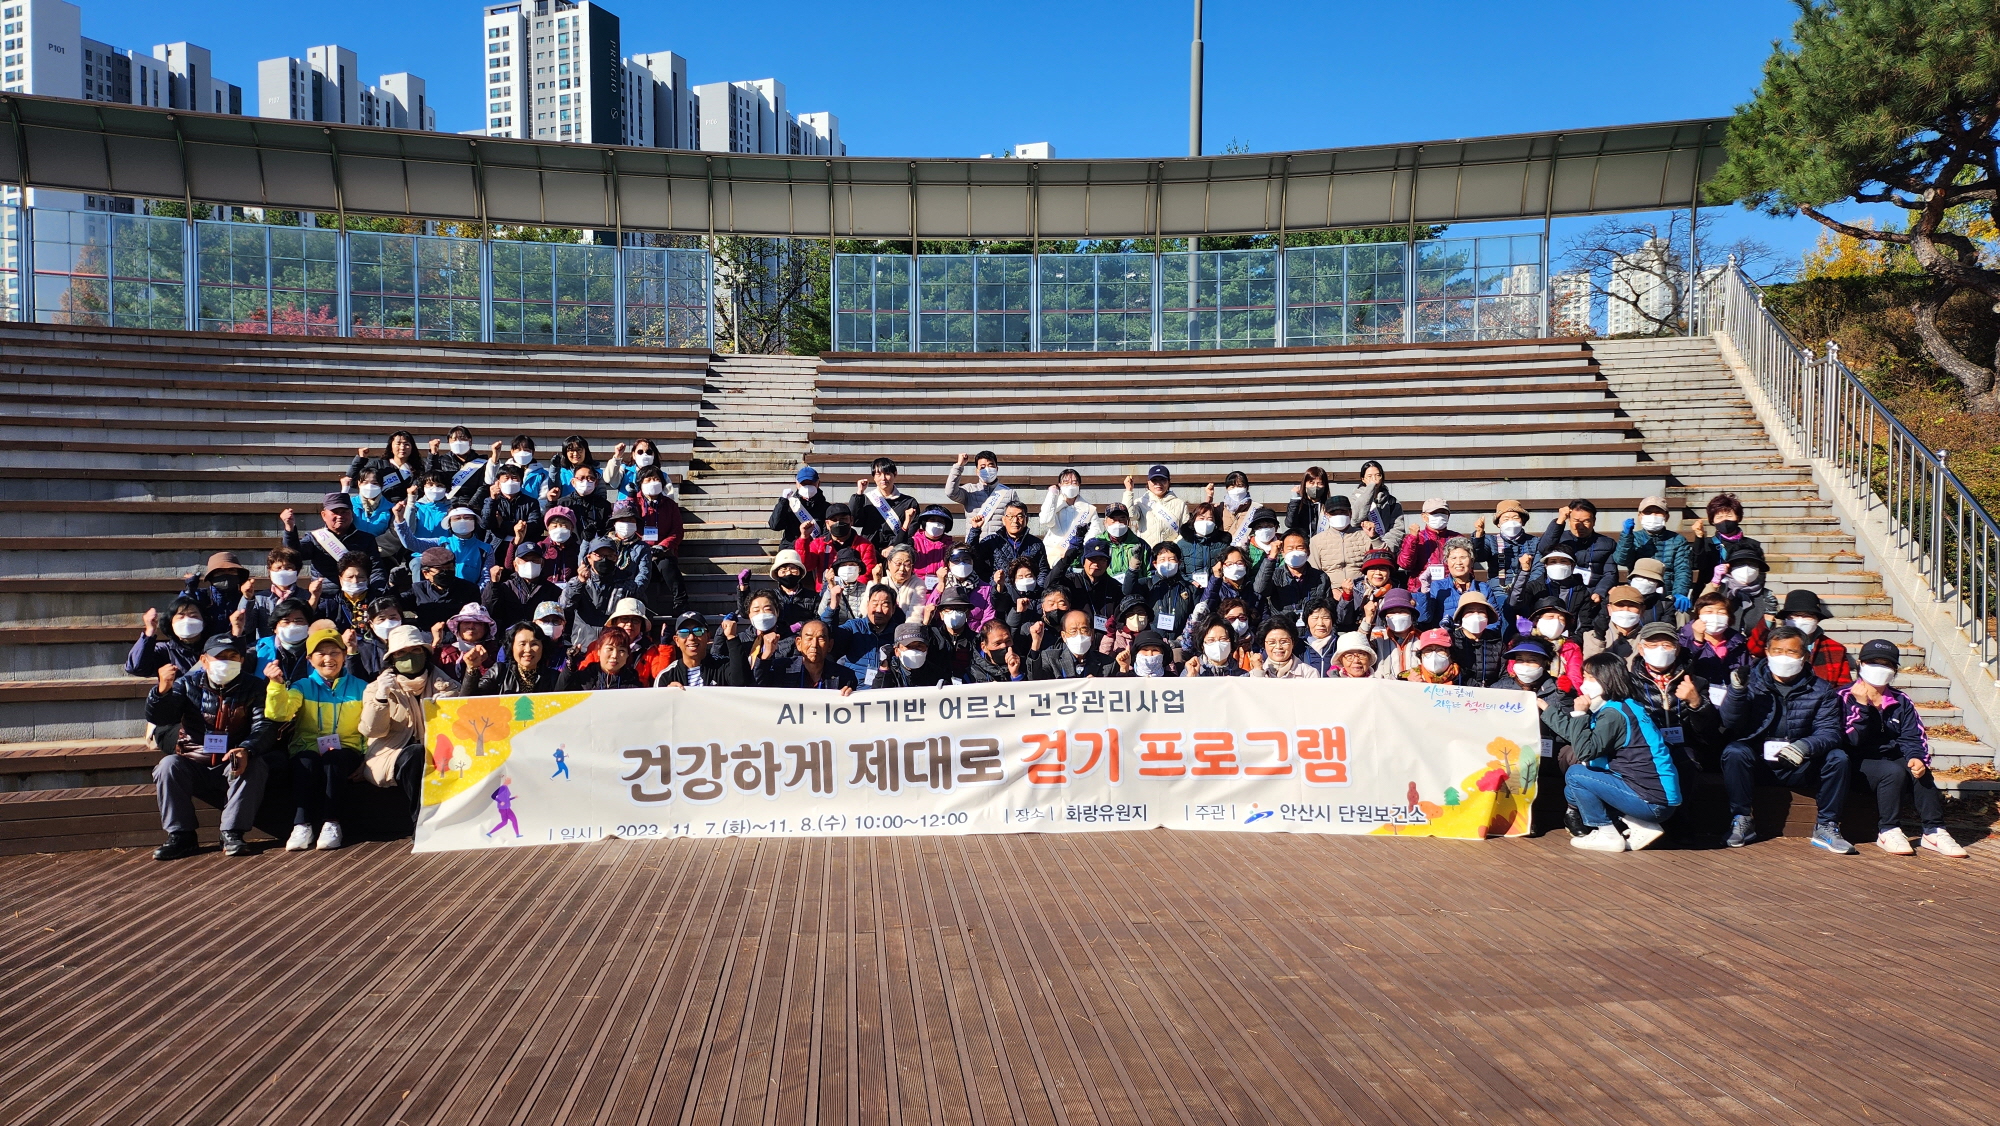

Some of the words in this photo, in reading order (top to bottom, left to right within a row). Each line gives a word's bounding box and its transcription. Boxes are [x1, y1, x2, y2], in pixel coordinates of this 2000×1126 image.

[48, 43, 65, 54] P101
[939, 694, 1016, 720] 어르신
[1028, 690, 1185, 717] 건강관리사업
[1499, 701, 1525, 713] 안산
[621, 740, 834, 802] 건강하게
[848, 735, 1004, 792] 제대로
[1020, 728, 1120, 785] 걷기
[1138, 725, 1348, 784] 프로그램
[855, 811, 968, 830] 10:00~12:00
[1015, 807, 1045, 823] 장소
[1066, 804, 1147, 823] 화랑유원지
[1195, 804, 1226, 821] 주관
[1280, 803, 1331, 823] 안산시
[1338, 804, 1426, 824] 단원보건소
[560, 826, 591, 839] 일시
